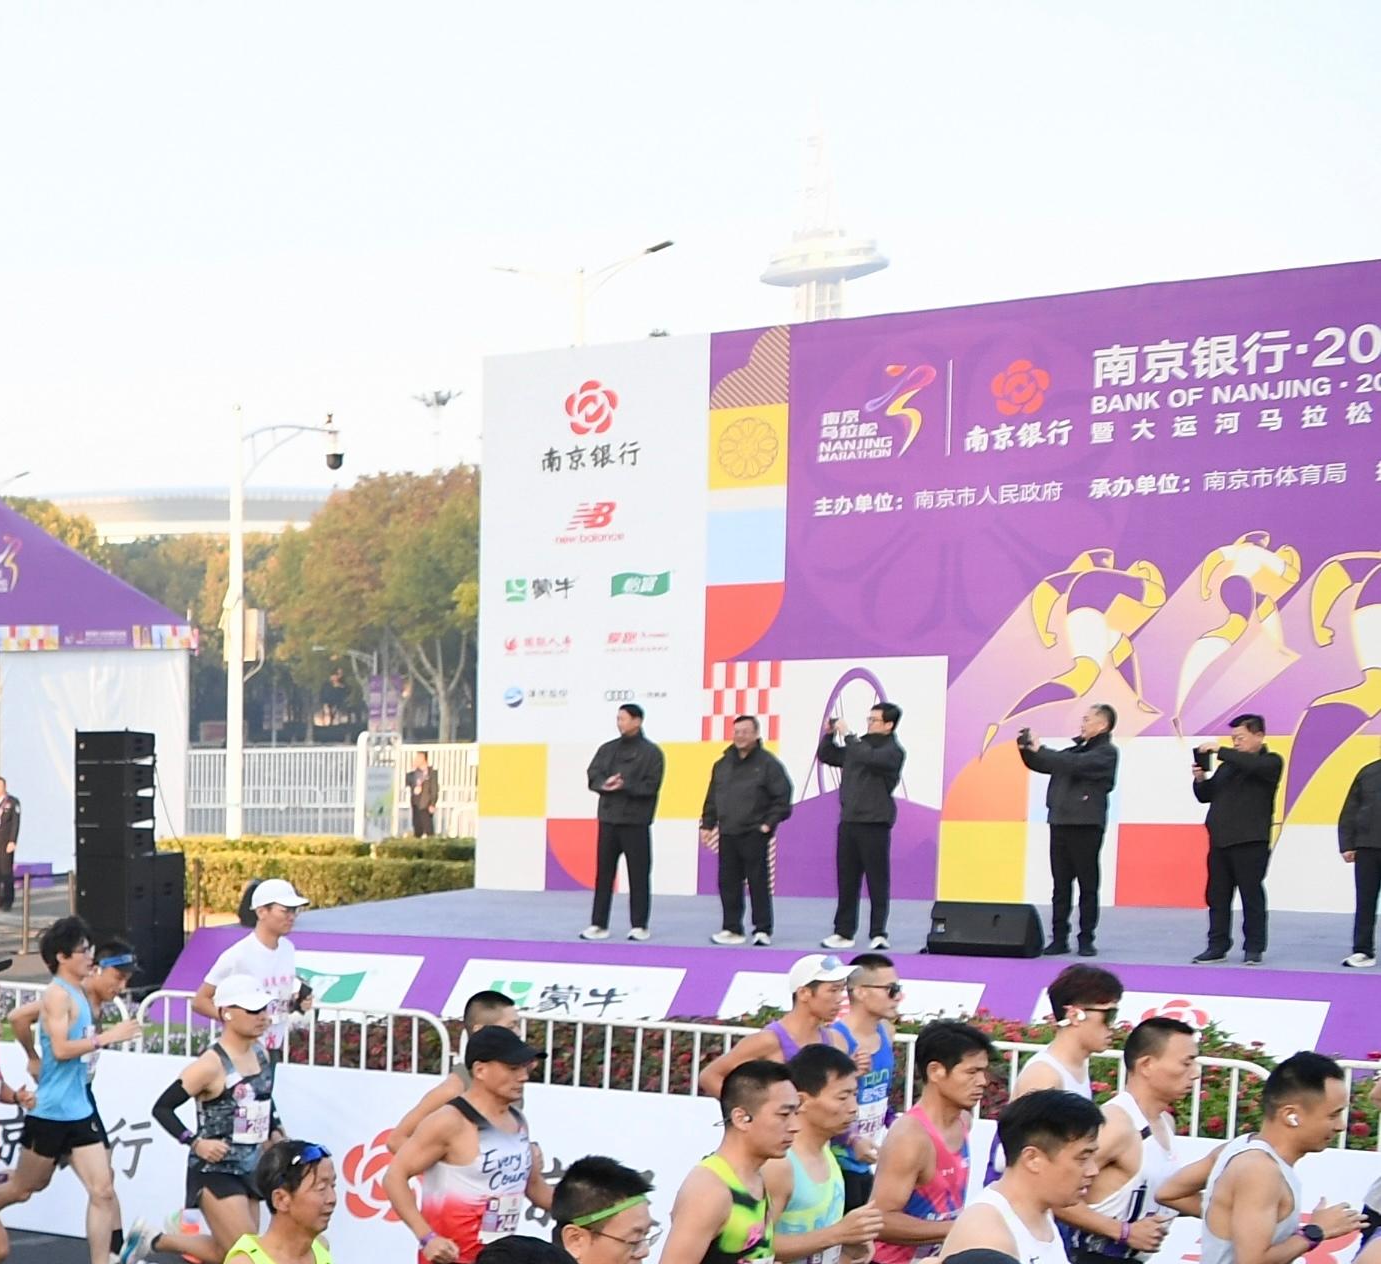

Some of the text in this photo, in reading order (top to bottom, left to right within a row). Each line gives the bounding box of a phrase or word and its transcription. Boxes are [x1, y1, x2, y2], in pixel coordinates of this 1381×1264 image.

[1090, 390, 1160, 415] BANK
[1168, 387, 1205, 409] OF
[1211, 376, 1332, 404] NANJING
[820, 421, 879, 440] 马拉松
[821, 409, 860, 427] 南京
[819, 436, 893, 452] NANJING
[964, 418, 1074, 453] 南京银行
[541, 440, 641, 472] 南京银行
[817, 447, 892, 463] MARATHON
[1202, 462, 1348, 492] 南京市体育局
[914, 479, 1064, 509] 南京市人民政府
[538, 984, 628, 1017] 蒙牛
[482, 1148, 522, 1174] Every
